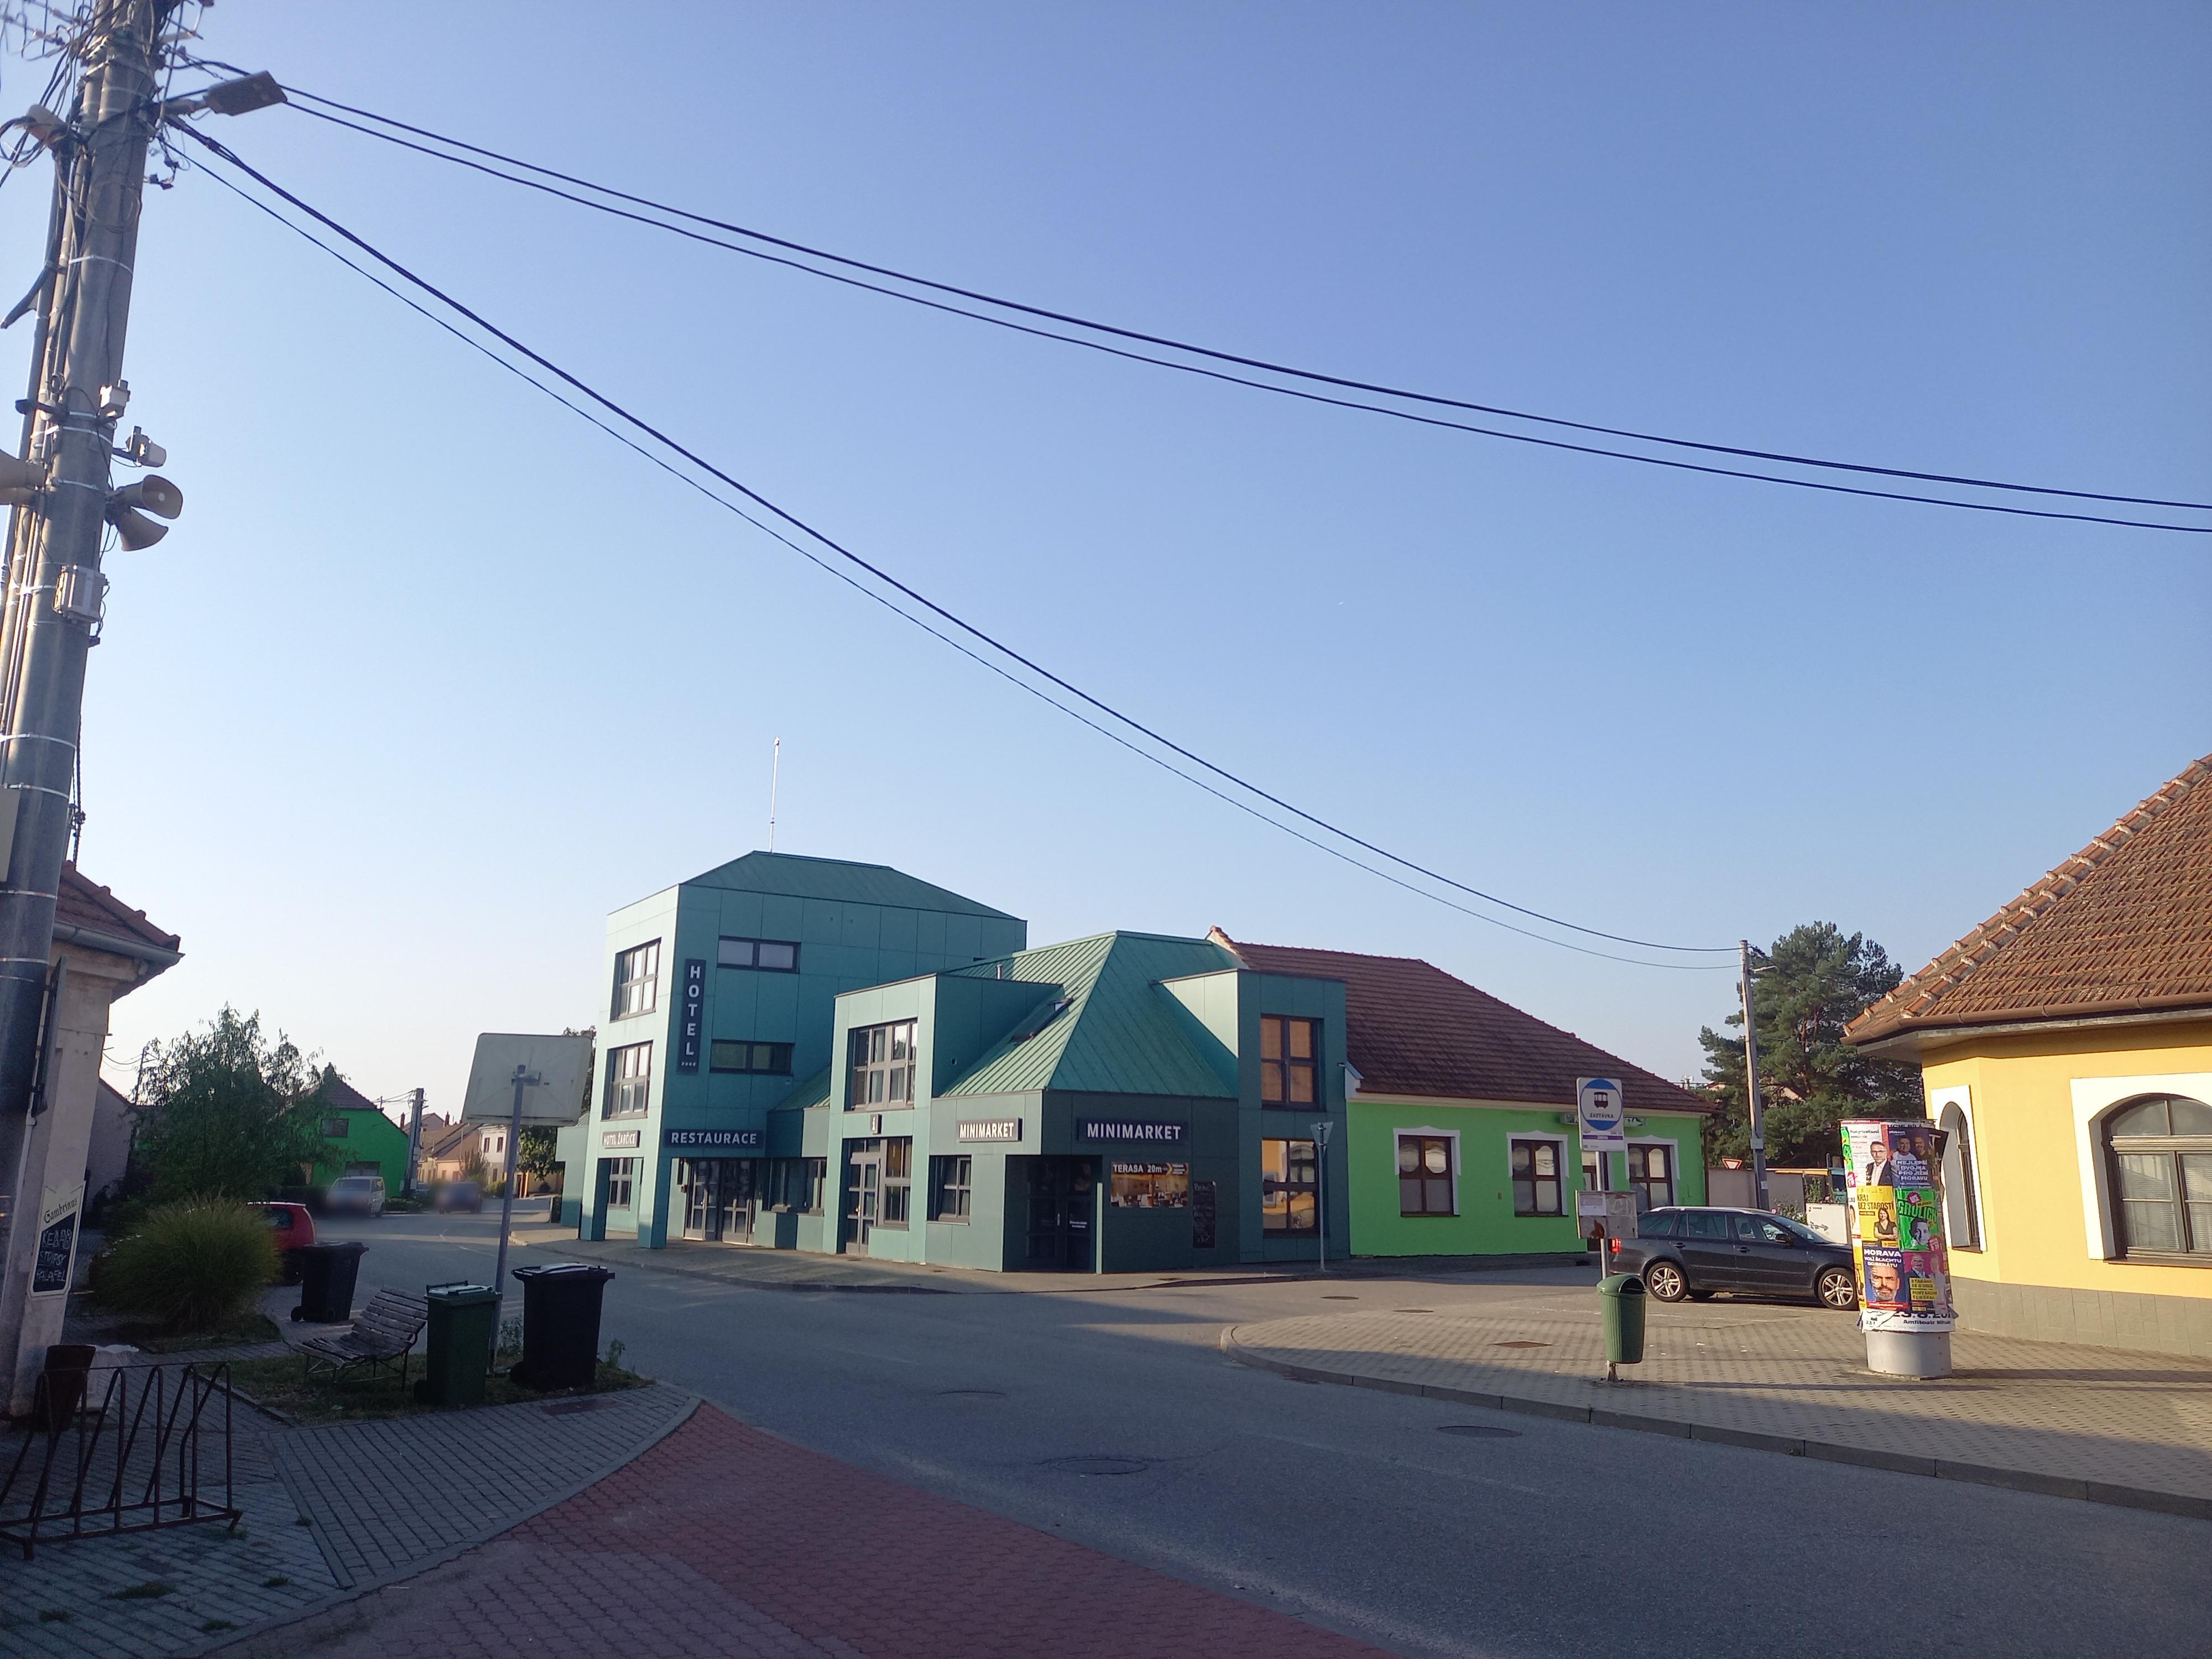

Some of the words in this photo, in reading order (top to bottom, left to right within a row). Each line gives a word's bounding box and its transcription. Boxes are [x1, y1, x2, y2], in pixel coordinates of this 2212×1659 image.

[685, 965, 701, 1056] HOTEL
[959, 1122, 1014, 1138] MINIMARKET
[1087, 1123, 1181, 1140] MINIMARKET
[603, 1135, 616, 1145] HOTEL
[671, 1132, 757, 1144] RESTAURACE
[1113, 1164, 1144, 1173] TERASA
[1147, 1165, 1162, 1173] 20m
[44, 1197, 77, 1224] Gambrinus
[1864, 1249, 1902, 1258] MORAVA
